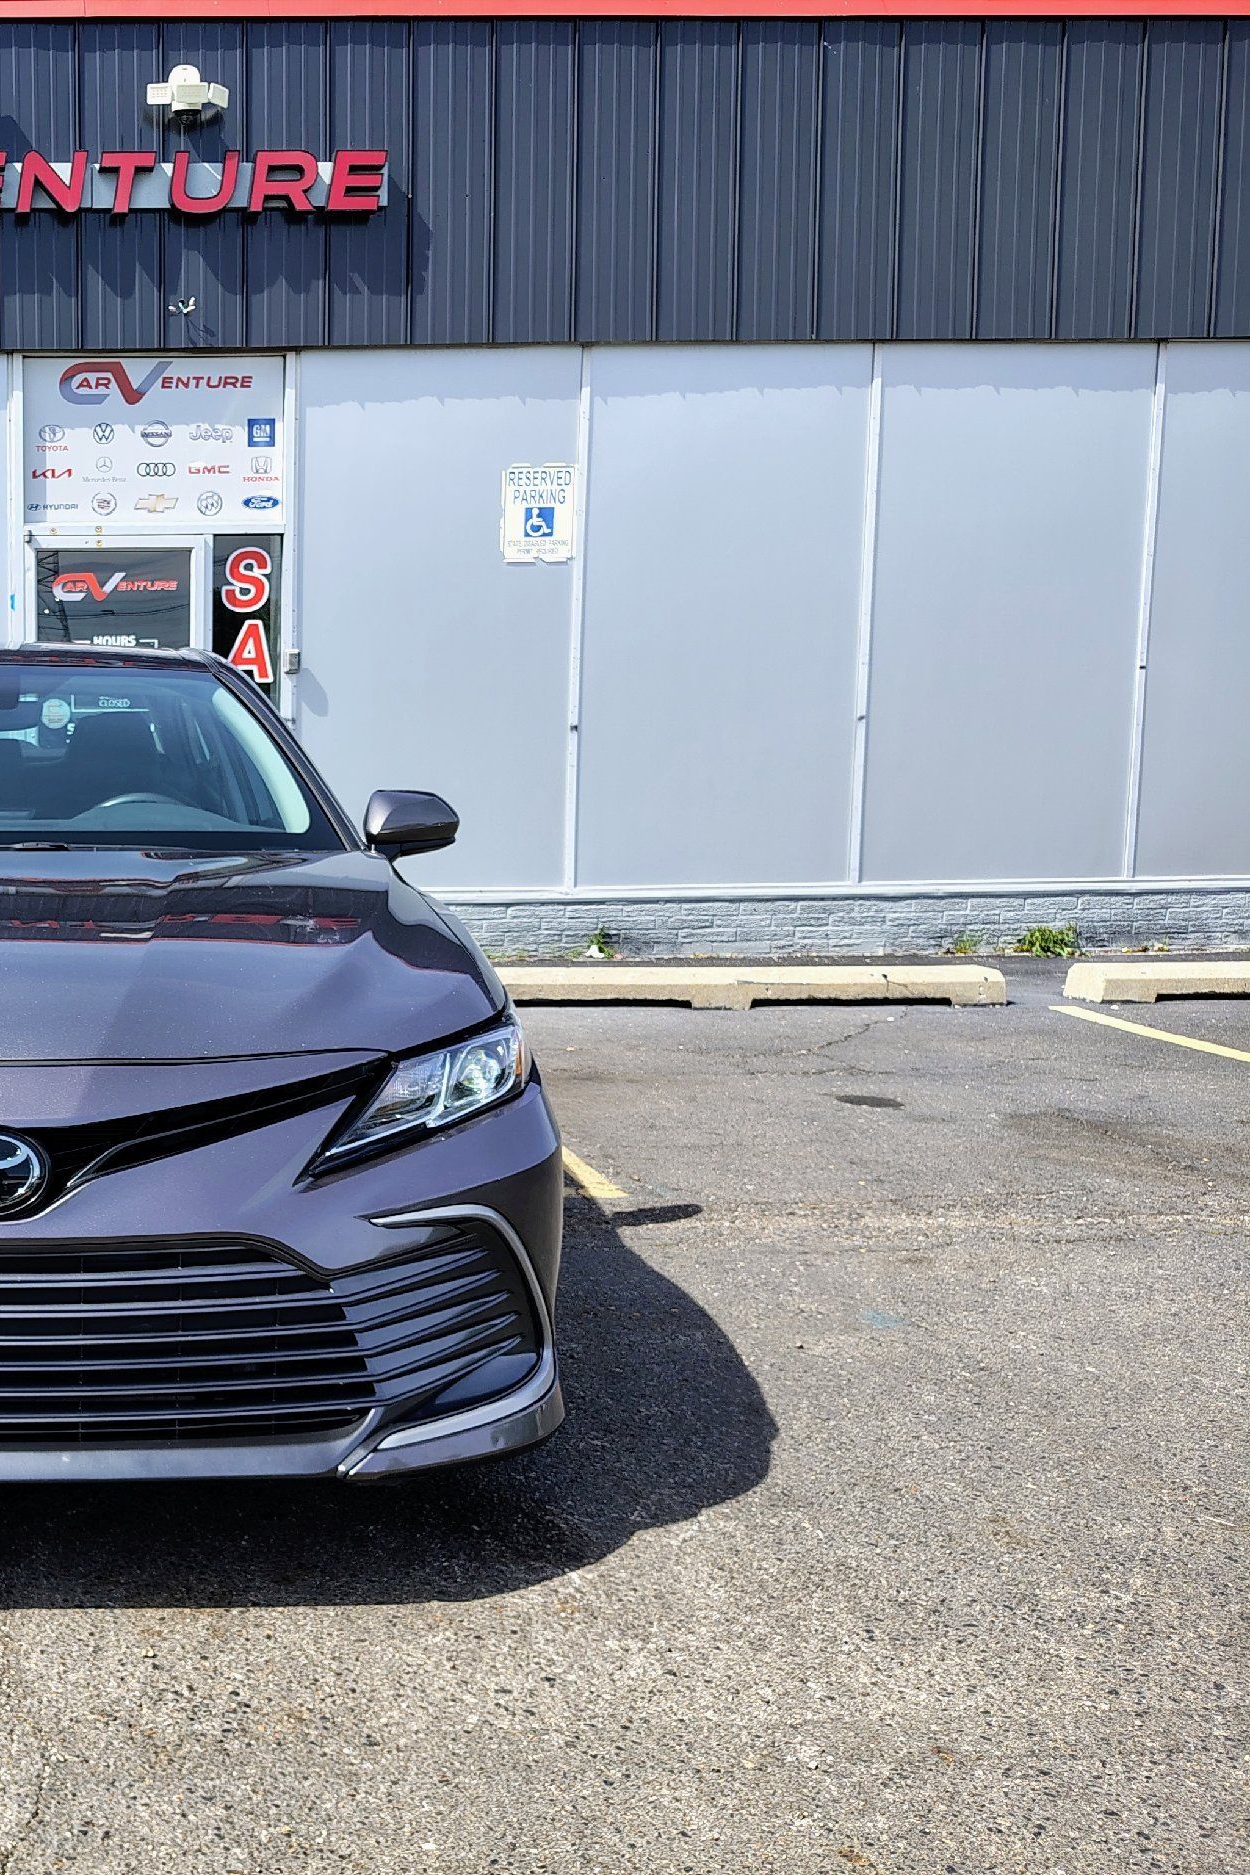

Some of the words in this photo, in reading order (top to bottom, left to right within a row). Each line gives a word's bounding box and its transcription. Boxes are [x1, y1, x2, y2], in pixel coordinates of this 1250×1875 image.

[189, 424, 233, 443] Jeep
[188, 465, 230, 474] GMC
[508, 471, 571, 486] RESERVED
[513, 489, 566, 504] PARKING
[92, 634, 136, 646] HOURS
